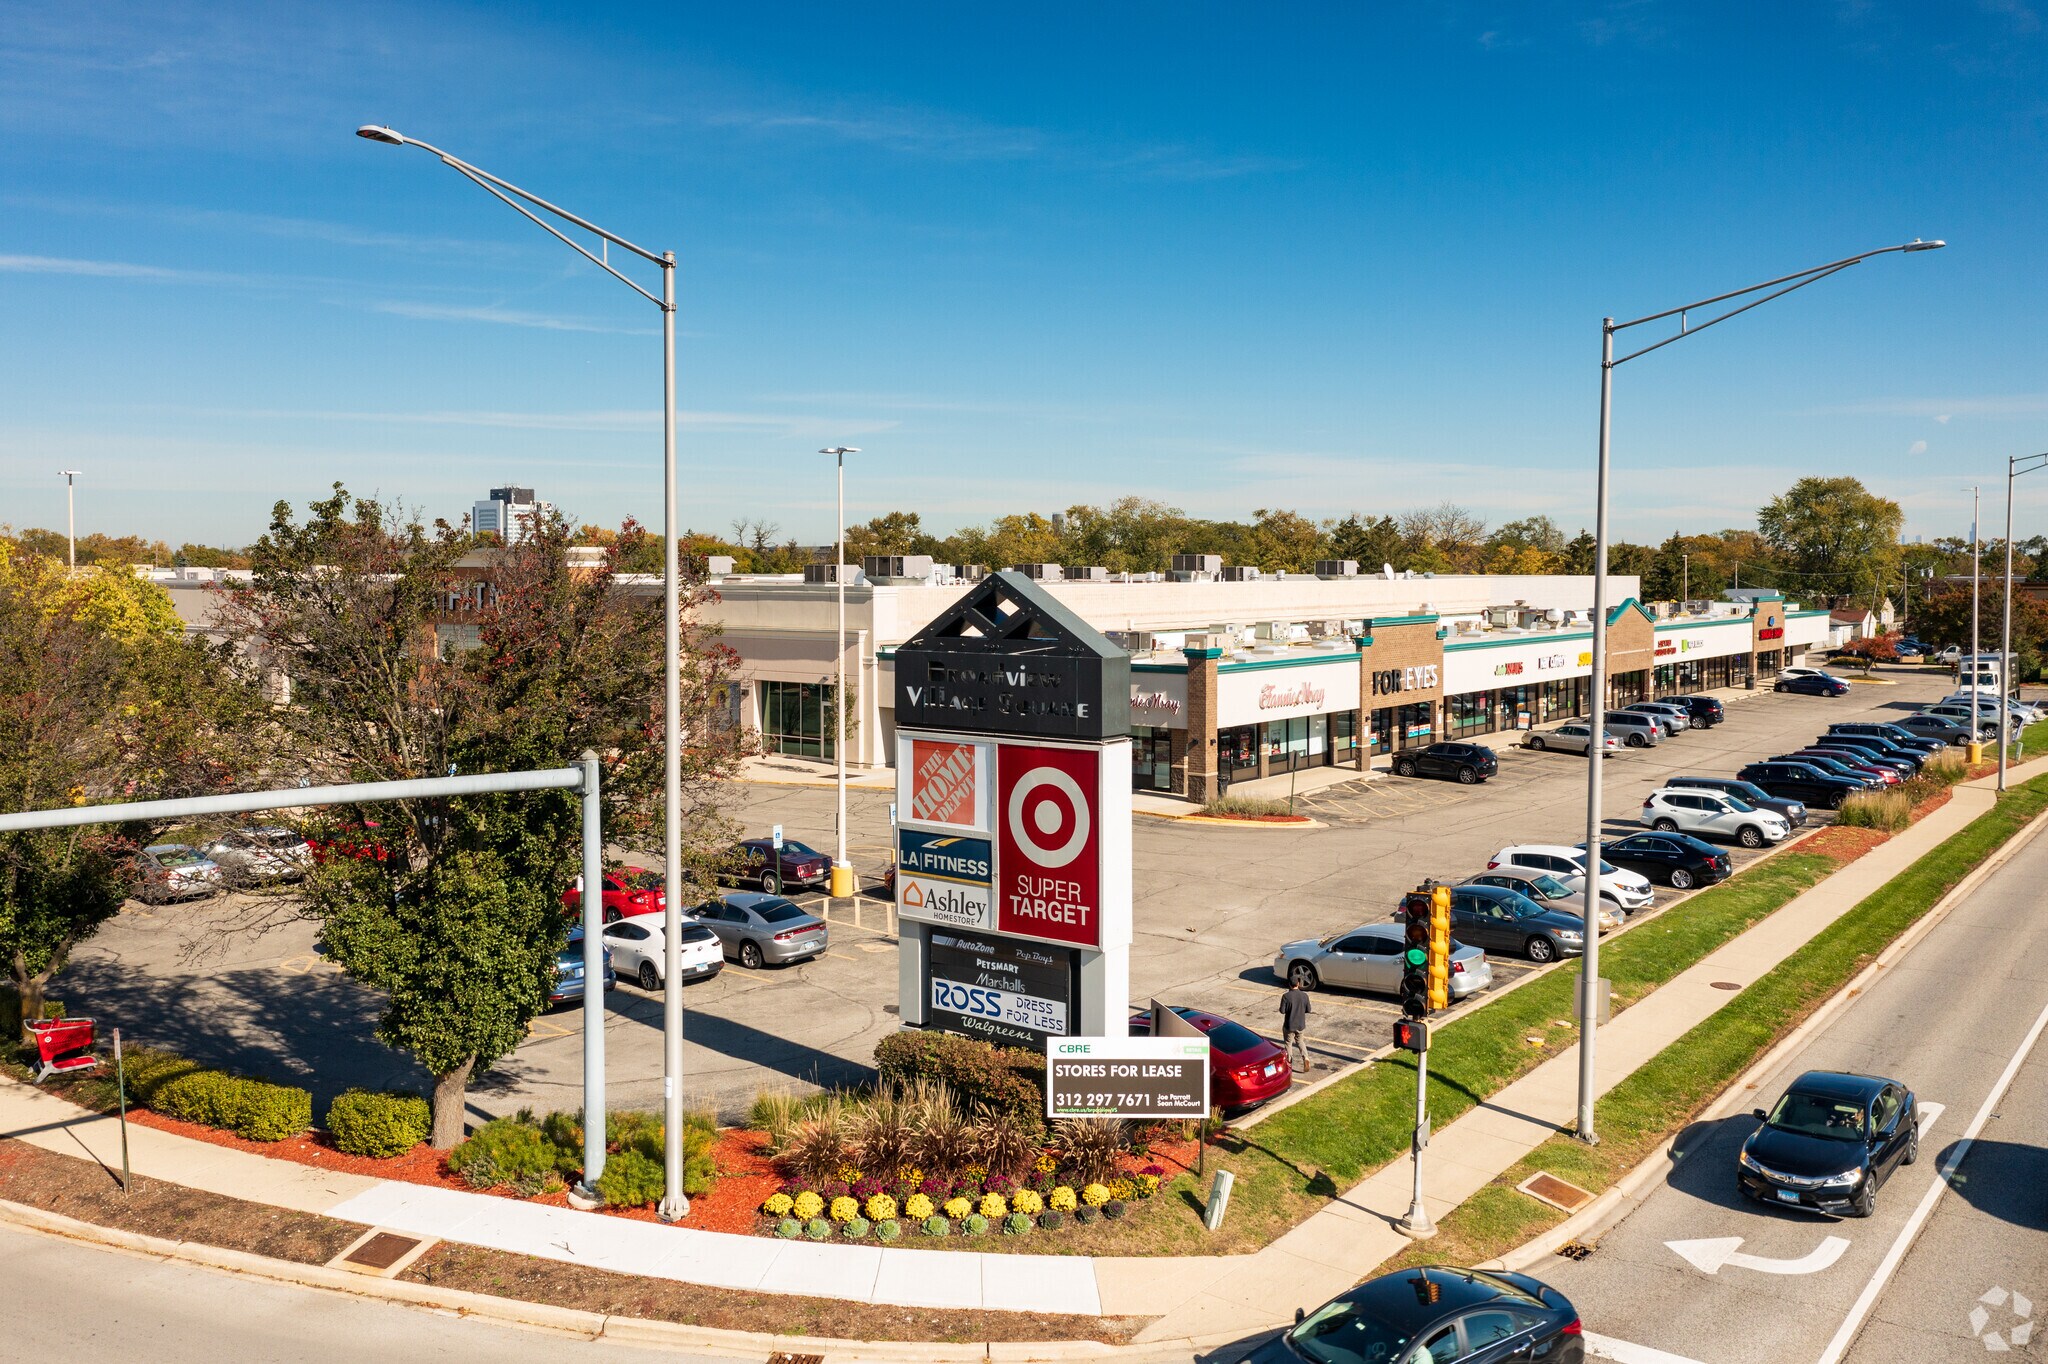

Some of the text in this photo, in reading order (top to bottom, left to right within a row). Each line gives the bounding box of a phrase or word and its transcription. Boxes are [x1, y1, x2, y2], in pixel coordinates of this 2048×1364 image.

[1372, 664, 1438, 696] FOR EYES
[918, 749, 945, 781] THE
[912, 744, 975, 820] HOME
[936, 775, 975, 822] DEPOT
[901, 849, 988, 877] LA FITNESS
[1018, 875, 1081, 902] SUPER
[924, 888, 986, 923] Ashley
[934, 912, 975, 925] HOMESTORE
[1010, 895, 1090, 926] TARGET
[956, 940, 995, 954] AutoZone
[1032, 952, 1054, 964] Boys
[975, 973, 1026, 994] Marshalls
[935, 981, 1001, 1017] ROSS
[1016, 997, 1053, 1014] DRESS
[961, 1016, 1034, 1042] Walgreens
[1006, 1010, 1064, 1031] FOR LESS
[1059, 1044, 1091, 1053] CBRE
[1056, 1065, 1182, 1077] STORES FOR LEASE
[1056, 1093, 1150, 1107] 312 297 7671
